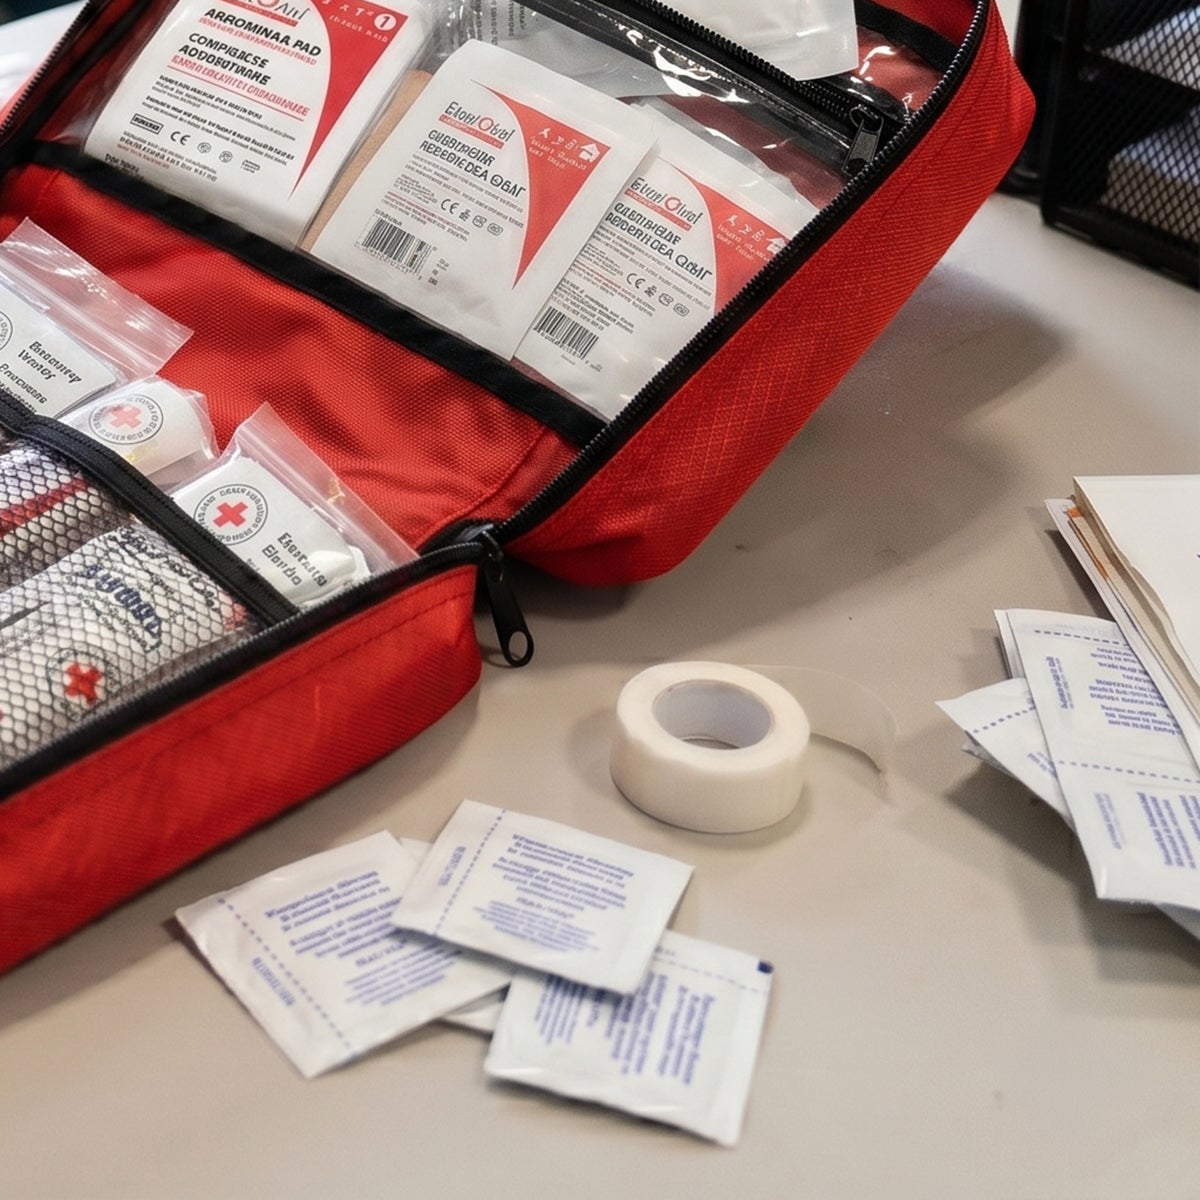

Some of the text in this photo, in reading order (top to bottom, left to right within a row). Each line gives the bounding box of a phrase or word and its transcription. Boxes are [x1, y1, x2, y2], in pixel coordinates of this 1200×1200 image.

[292, 39, 322, 58] PAD
[440, 198, 460, 215] CE
[626, 272, 646, 290] CE
